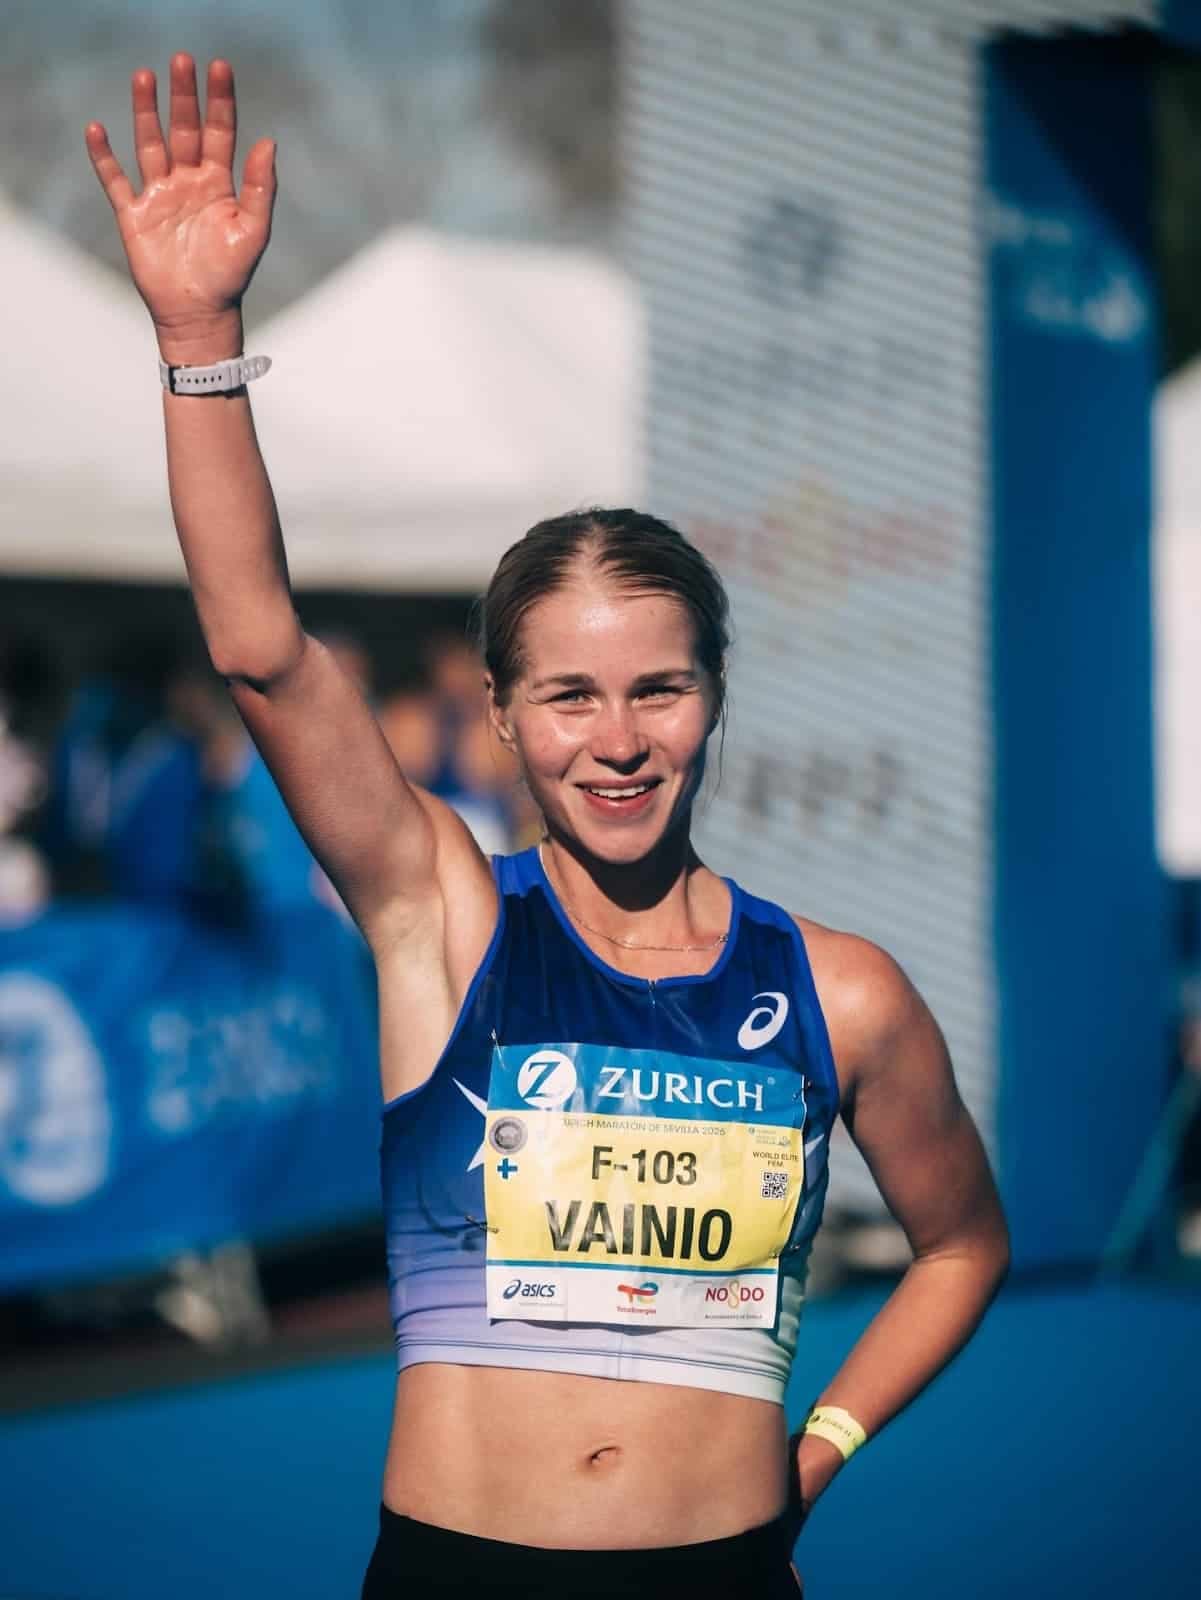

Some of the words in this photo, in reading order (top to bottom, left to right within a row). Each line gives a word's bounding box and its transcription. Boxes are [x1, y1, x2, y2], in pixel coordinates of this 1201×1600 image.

[522, 1061, 561, 1099] Z
[599, 1066, 764, 1112] ZURICH
[648, 1122, 661, 1133] DE
[591, 1145, 698, 1186] F-103
[752, 1151, 780, 1160] WORLD
[781, 1153, 799, 1162] ELITE
[545, 1199, 733, 1262] VAINIO
[521, 1283, 556, 1298] asics
